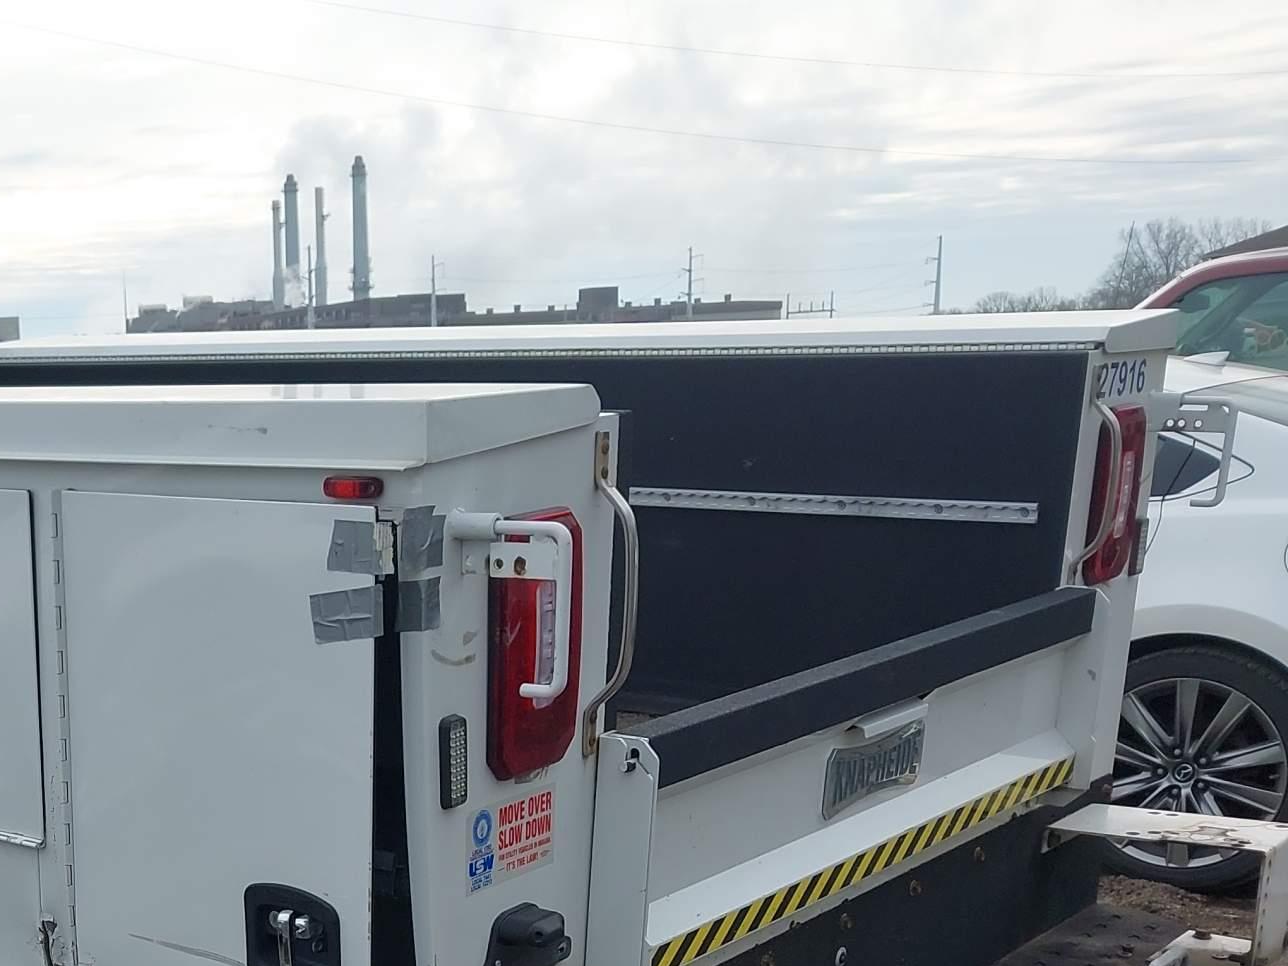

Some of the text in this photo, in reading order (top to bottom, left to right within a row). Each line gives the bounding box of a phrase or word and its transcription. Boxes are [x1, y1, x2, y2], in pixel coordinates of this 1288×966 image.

[1096, 358, 1146, 400] 27916
[498, 791, 552, 828] MOVE OVER
[498, 812, 552, 850] SLOW DOWN
